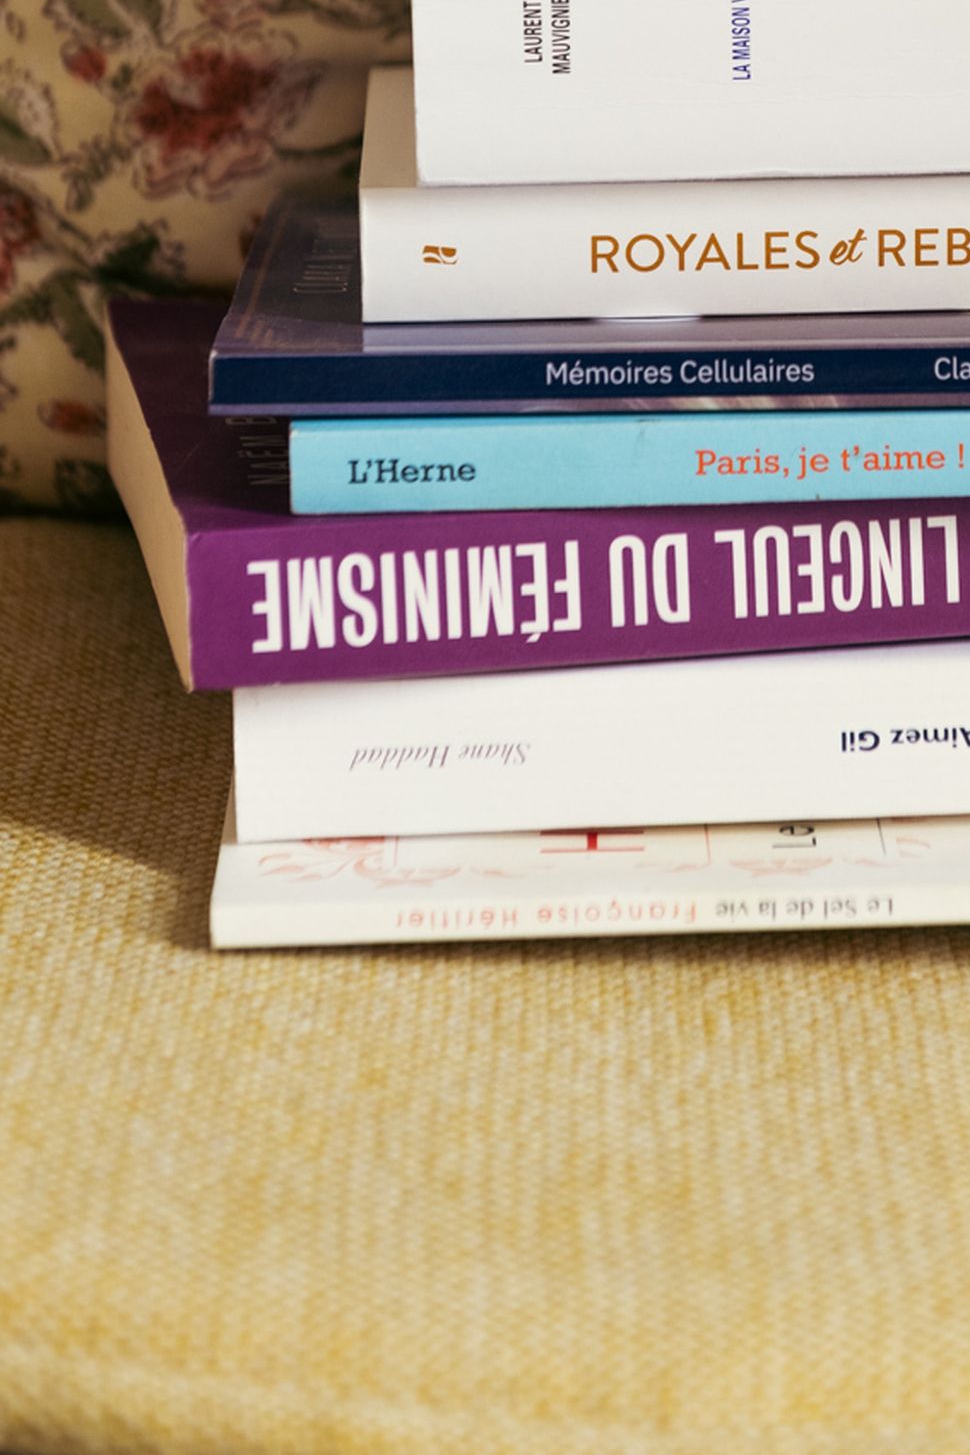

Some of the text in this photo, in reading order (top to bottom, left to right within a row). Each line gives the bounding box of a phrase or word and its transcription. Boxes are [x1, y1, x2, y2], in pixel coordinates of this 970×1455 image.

[522, 1, 543, 63] LAURENT
[730, 6, 752, 61] MAISON
[731, 61, 752, 82] LA
[591, 230, 821, 274] ROYALES
[829, 228, 867, 266] et
[546, 358, 815, 386] Mémoires Cellulaires
[348, 458, 476, 484] L'Herne
[696, 448, 789, 477] Paris,
[797, 447, 829, 480] je
[841, 445, 945, 471] t'aime
[608, 532, 691, 628] DU
[713, 515, 960, 619] LINCEUL
[246, 539, 582, 654] FÉMINISME
[348, 742, 531, 771] Shane Haddad
[841, 730, 880, 752] Gil
[536, 897, 698, 926] Françoise
[714, 895, 894, 922] Le Sel de la vie
